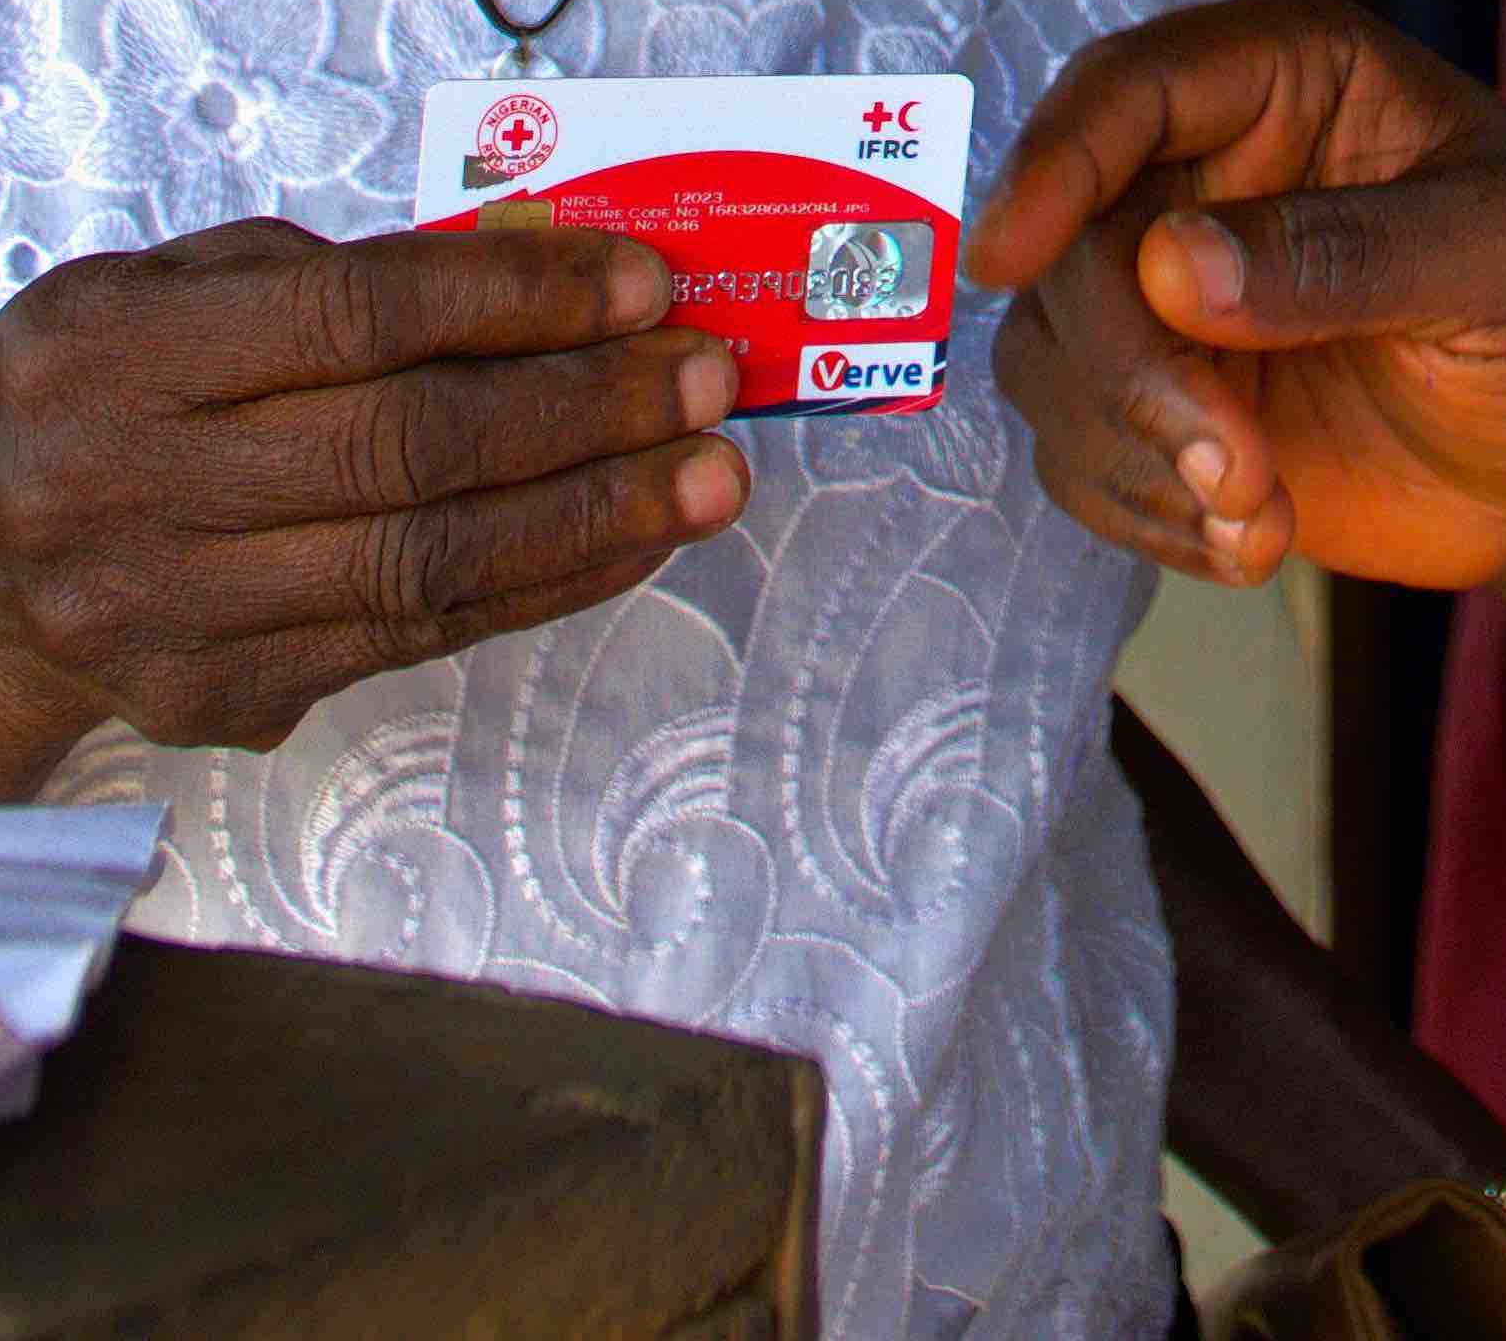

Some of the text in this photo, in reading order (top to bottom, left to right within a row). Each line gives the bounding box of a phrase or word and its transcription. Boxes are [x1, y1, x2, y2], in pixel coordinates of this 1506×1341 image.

[486, 100, 550, 127] NIGERIAN
[507, 144, 552, 173] CROSS
[857, 139, 920, 159] IFRC
[560, 195, 609, 208] NRCS
[813, 355, 923, 390] Verve
